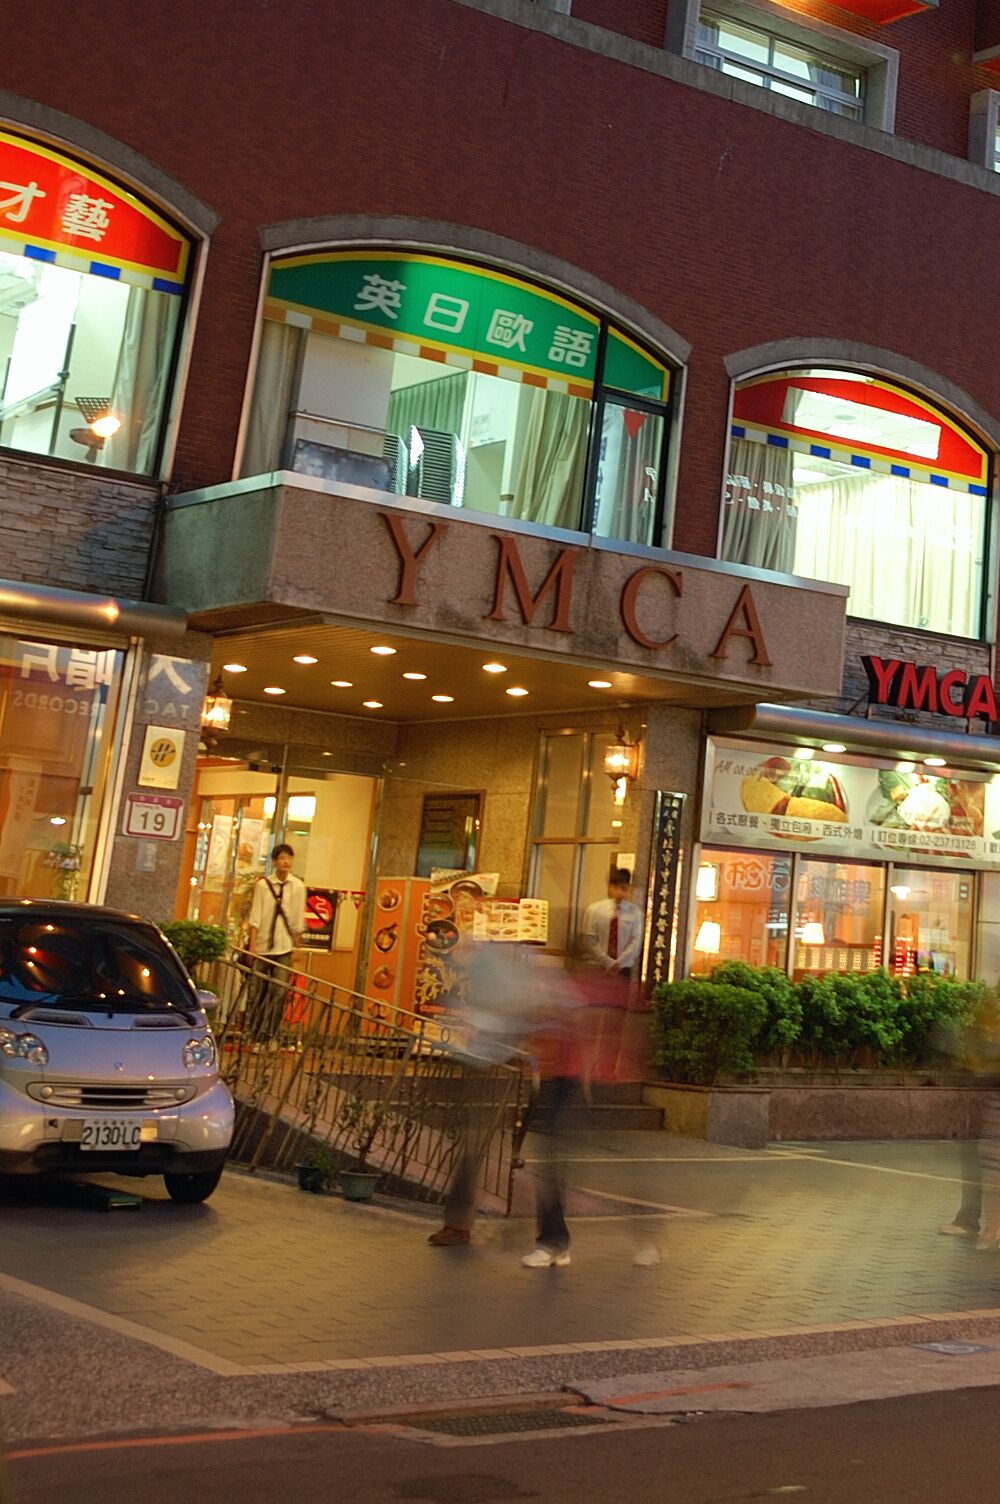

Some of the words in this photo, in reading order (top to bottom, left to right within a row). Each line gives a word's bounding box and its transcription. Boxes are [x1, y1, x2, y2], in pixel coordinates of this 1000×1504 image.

[0, 181, 115, 242] 才藝
[353, 273, 595, 369] 英日歐語
[377, 512, 774, 667] YMCA
[861, 655, 998, 723] YMCA
[140, 810, 166, 832] 19
